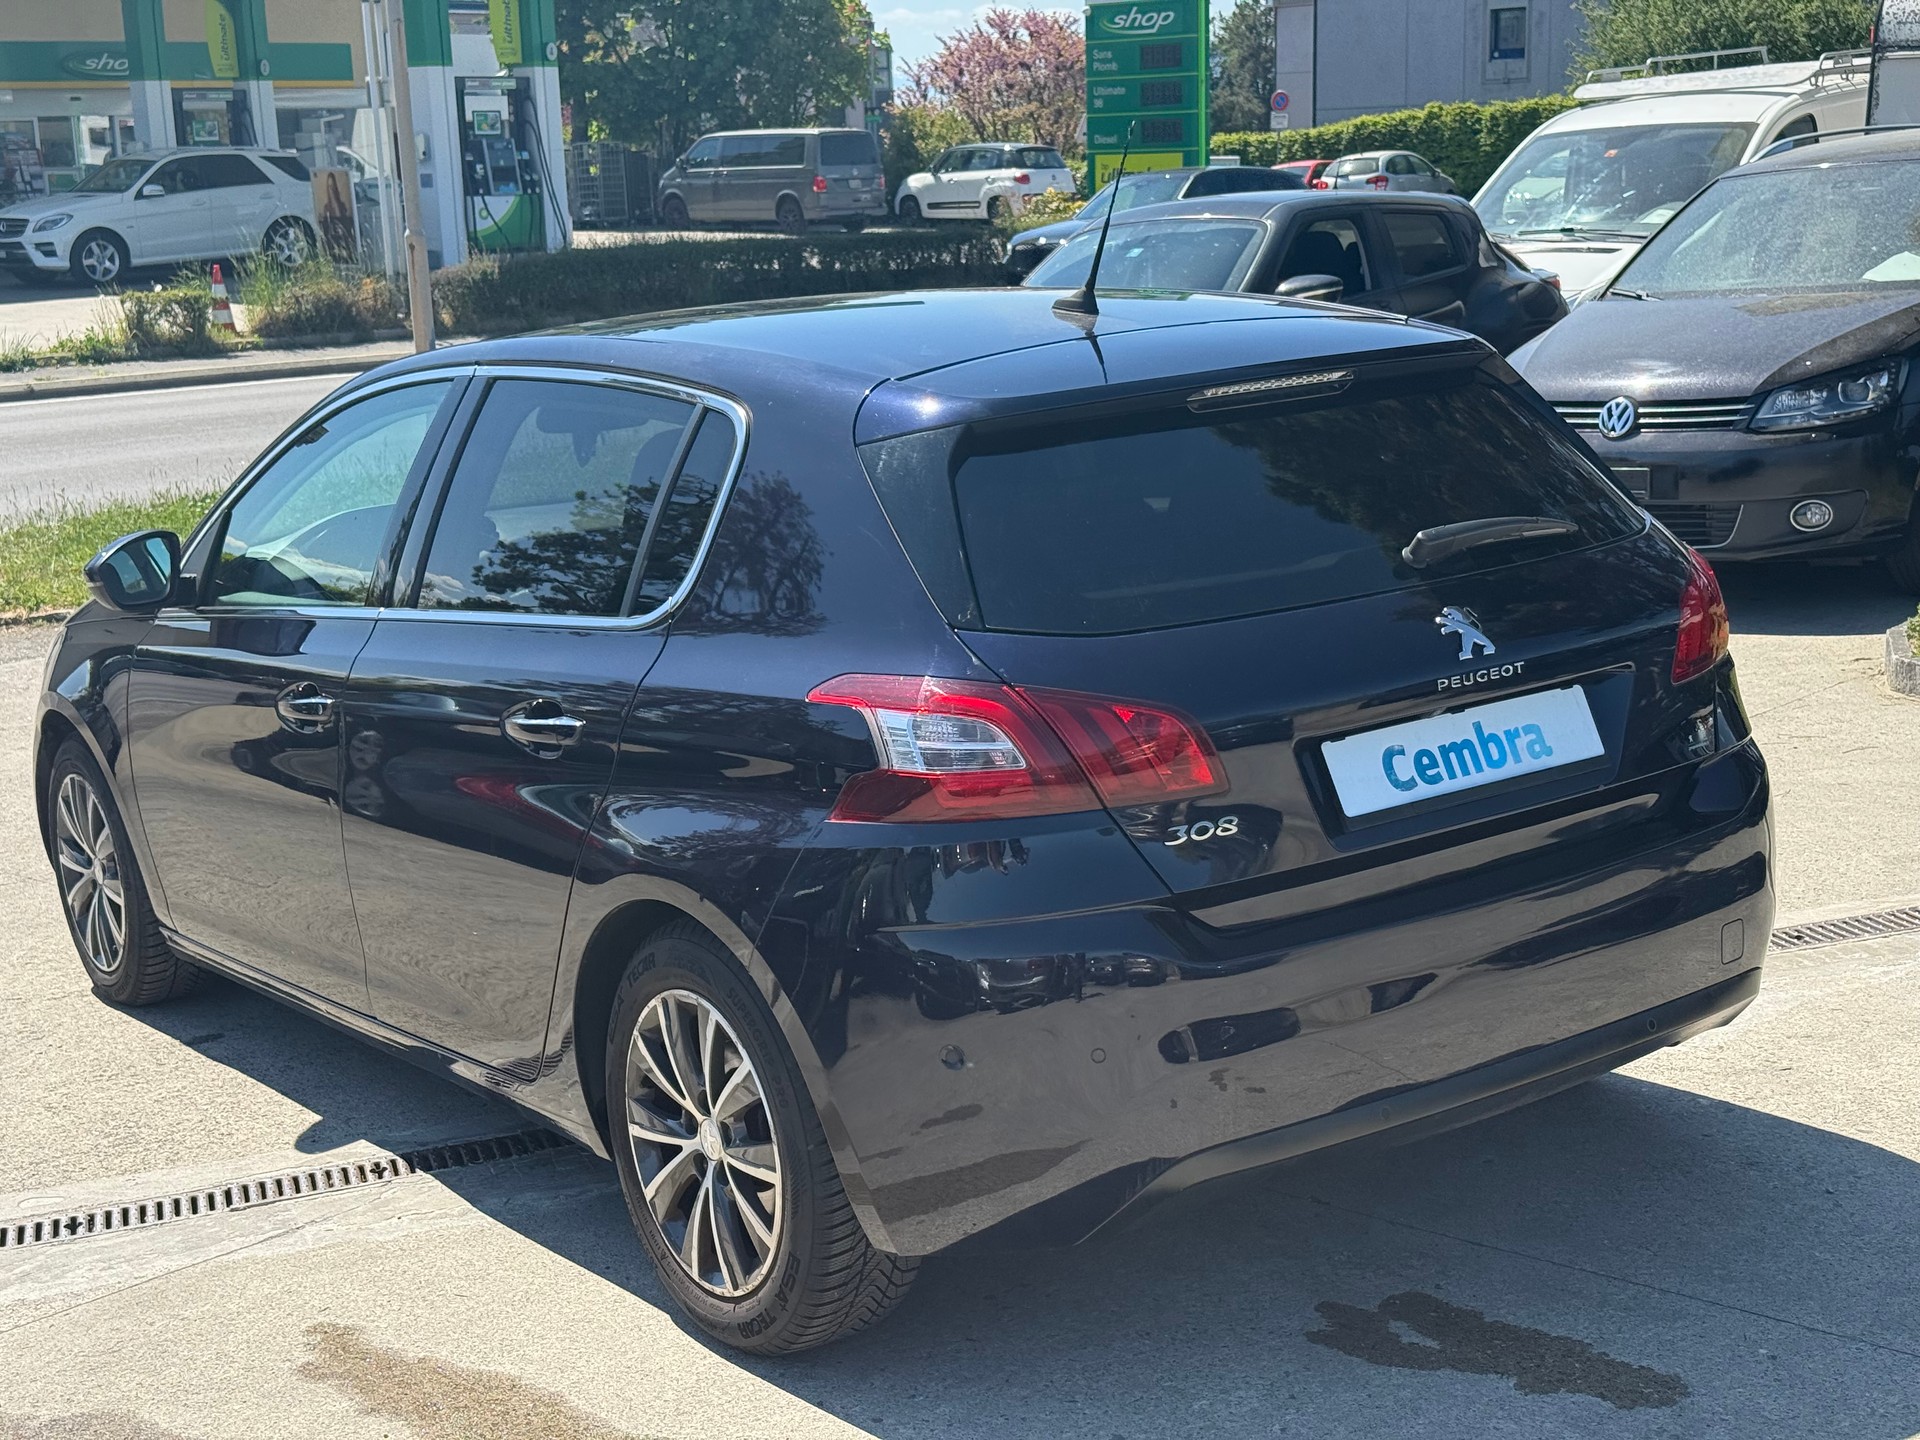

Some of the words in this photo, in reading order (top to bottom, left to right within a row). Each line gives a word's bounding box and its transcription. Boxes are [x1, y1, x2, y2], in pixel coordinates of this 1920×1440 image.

[1112, 6, 1175, 34] shop
[84, 53, 129, 75] sho
[1092, 49, 1113, 60] Sans
[1092, 61, 1119, 72] Plomb
[1092, 86, 1127, 96] Ultimate
[1094, 134, 1119, 145] Diesel
[1436, 660, 1526, 692] PEUGEOT
[1381, 720, 1554, 793] Cembra
[1164, 814, 1240, 847] 308
[626, 951, 657, 989] TECAR
[727, 986, 776, 1068] SUPERGRIP
[737, 1308, 778, 1340] TECAR
